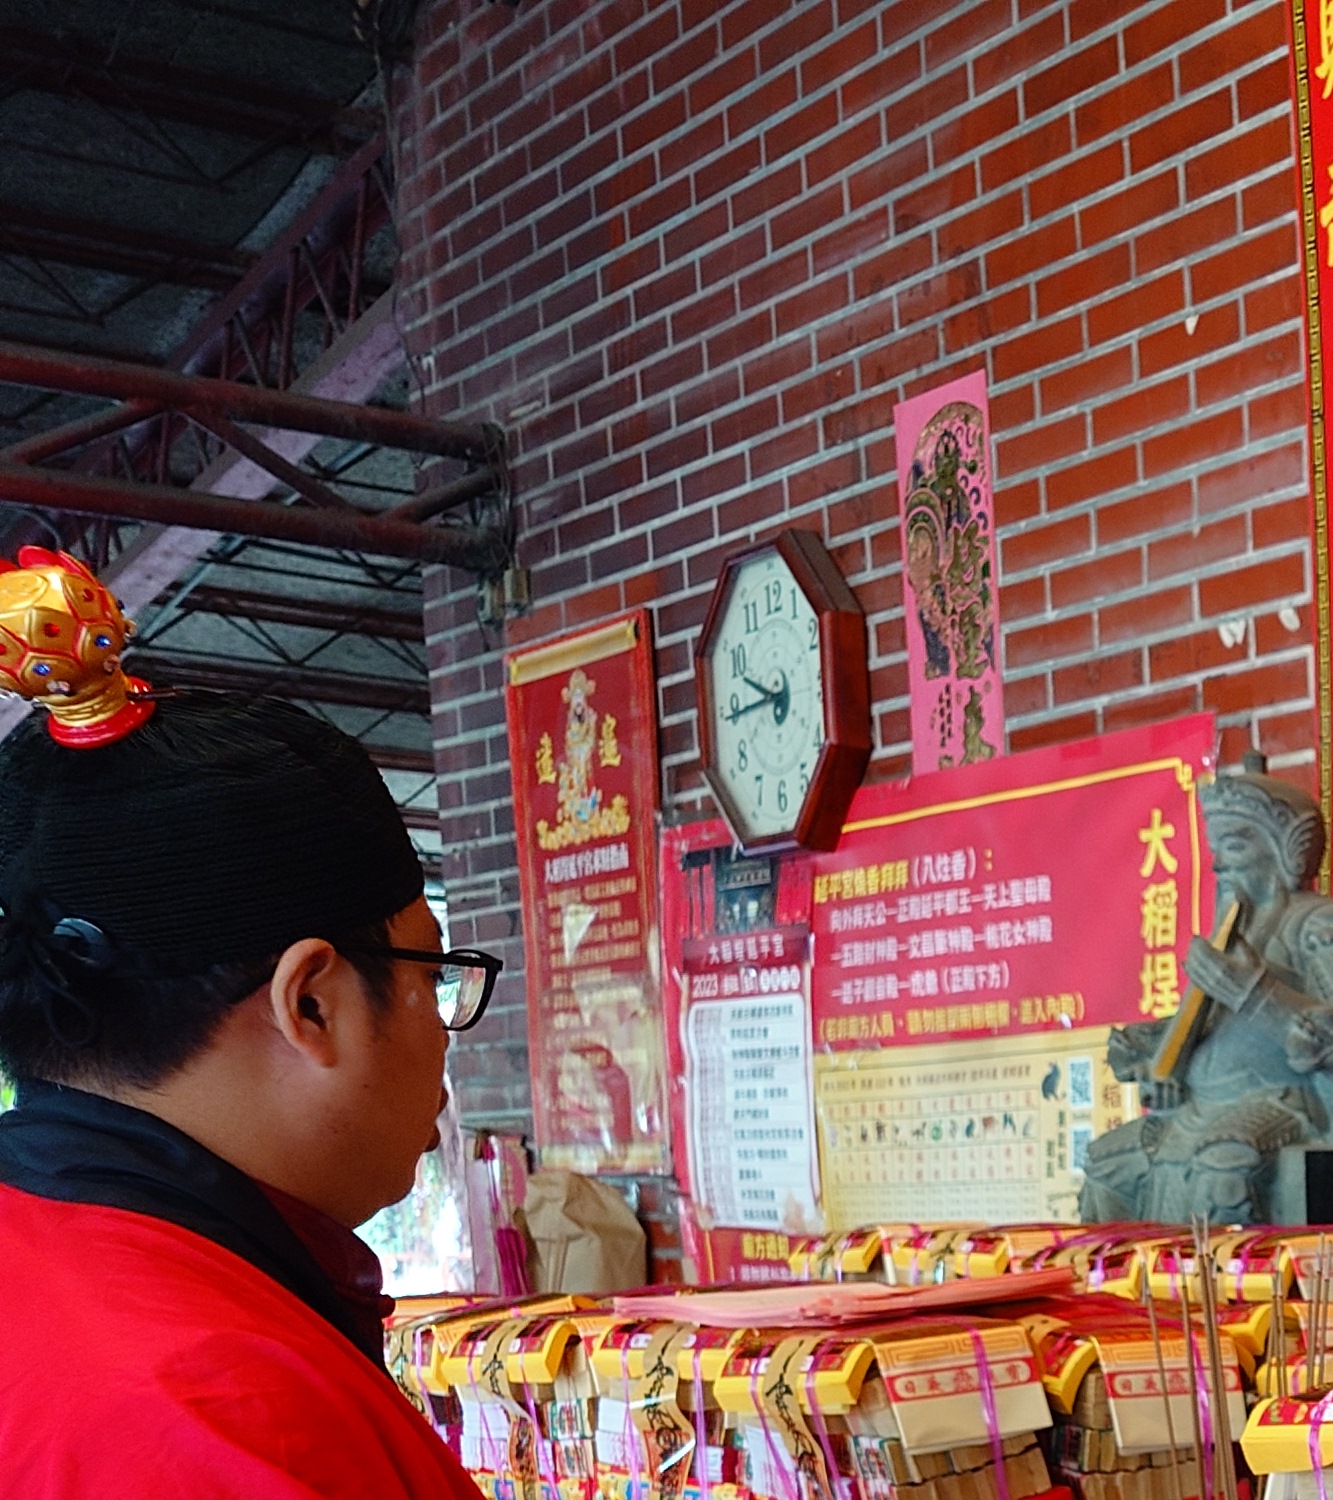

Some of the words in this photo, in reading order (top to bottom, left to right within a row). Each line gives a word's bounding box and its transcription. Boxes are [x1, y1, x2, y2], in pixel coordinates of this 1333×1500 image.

[764, 580, 783, 615] 12
[791, 588, 798, 620] 1
[743, 602, 759, 634] 11
[808, 618, 818, 650] 2
[731, 643, 746, 679] 10
[738, 739, 748, 772] 8
[755, 775, 763, 806] 7
[777, 780, 787, 812] 6
[1139, 808, 1181, 1018] 大稻埕
